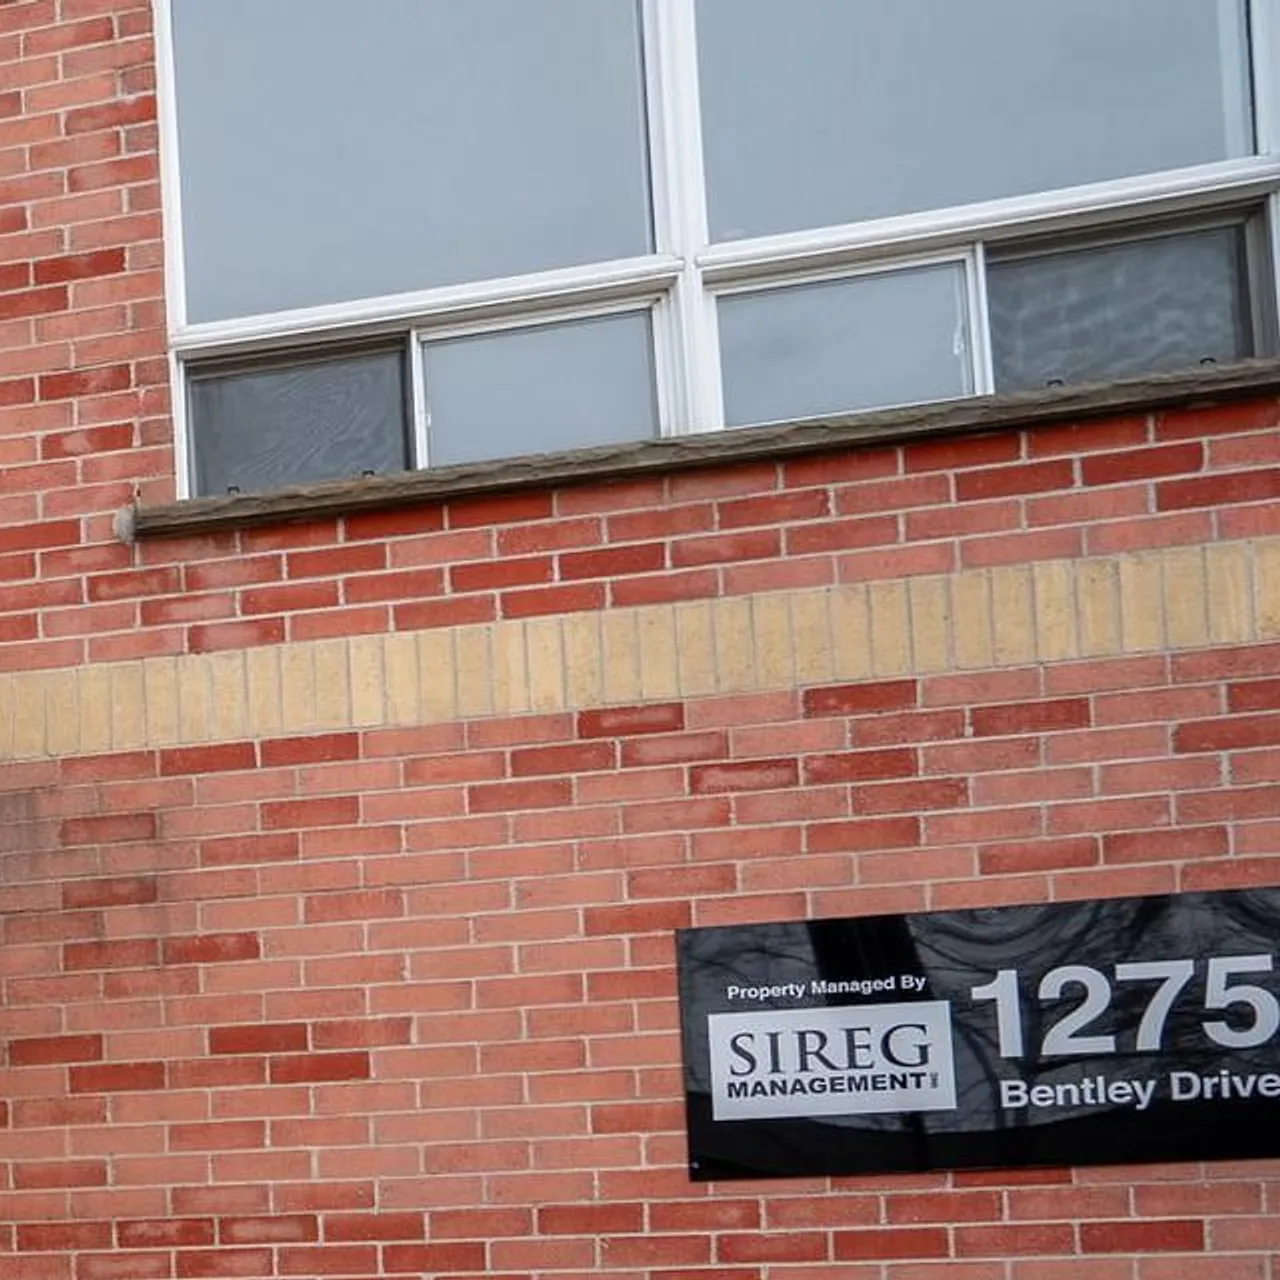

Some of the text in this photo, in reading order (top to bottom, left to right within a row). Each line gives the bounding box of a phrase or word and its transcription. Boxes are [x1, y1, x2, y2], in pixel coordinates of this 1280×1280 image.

[727, 974, 927, 1001] Property Managed By
[971, 953, 1280, 1058] 1275
[730, 1023, 933, 1077] SIREG
[727, 1072, 927, 1099] MANAGEMENT
[1000, 1070, 1280, 1111] Bentley Drive
